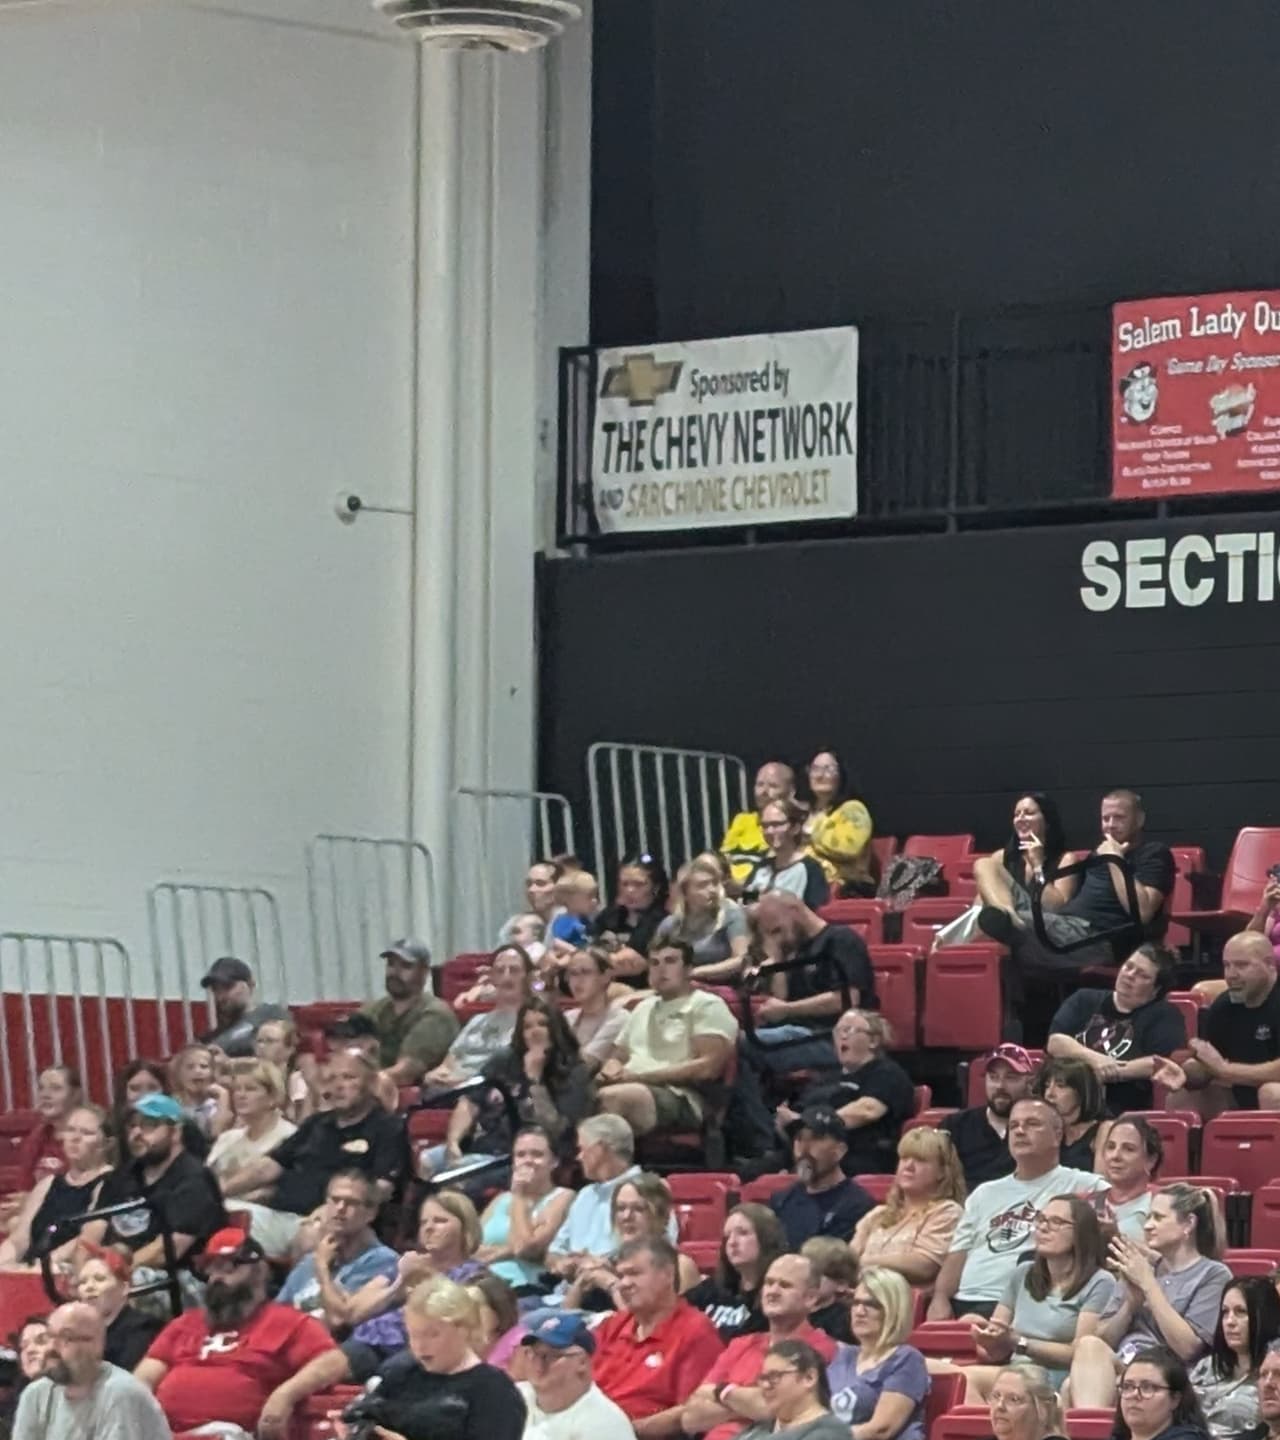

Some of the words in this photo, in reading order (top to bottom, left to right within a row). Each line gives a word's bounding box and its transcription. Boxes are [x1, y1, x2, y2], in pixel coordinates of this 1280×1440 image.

[1118, 316, 1182, 352] Salem
[1189, 303, 1247, 339] Lady
[689, 362, 771, 403] Sponsored
[773, 361, 790, 398] by
[602, 421, 646, 473] THE
[650, 412, 729, 470] CHEVY
[733, 401, 854, 465] NETWORK
[732, 470, 830, 510] CHEVROLET
